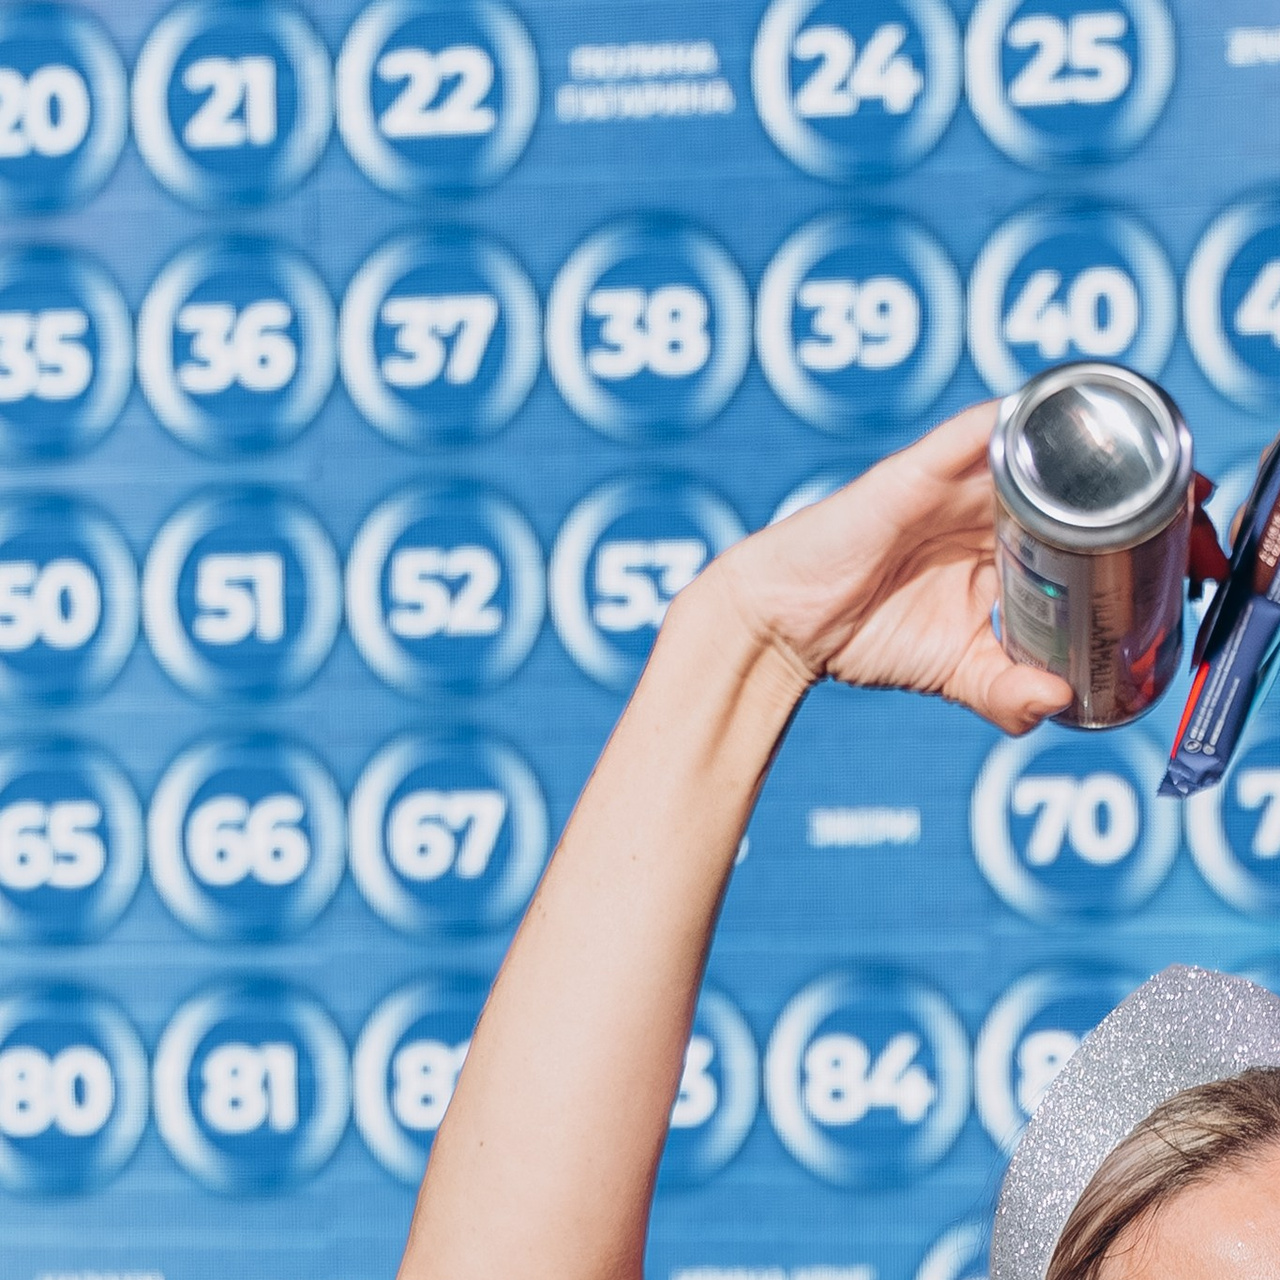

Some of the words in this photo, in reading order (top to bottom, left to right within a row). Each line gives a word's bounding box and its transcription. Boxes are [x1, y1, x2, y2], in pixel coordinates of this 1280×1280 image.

[185, 58, 275, 147] 21
[379, 47, 495, 137] 22
[794, 26, 922, 117] 24
[1009, 15, 1130, 106] 25
[176, 301, 296, 394] 36
[381, 295, 499, 387] 37
[587, 286, 711, 378] 38
[800, 277, 919, 370] 39
[1006, 267, 1139, 358] 40
[196, 554, 283, 643] 51
[390, 547, 501, 637] 52
[0, 802, 104, 888] 65
[188, 797, 309, 884] 66
[388, 792, 506, 879] 67
[1011, 774, 1140, 866] 70
[0, 1048, 114, 1135] 80
[203, 1045, 296, 1132] 81
[394, 1043, 474, 1132] 8
[803, 1036, 936, 1126] 84
